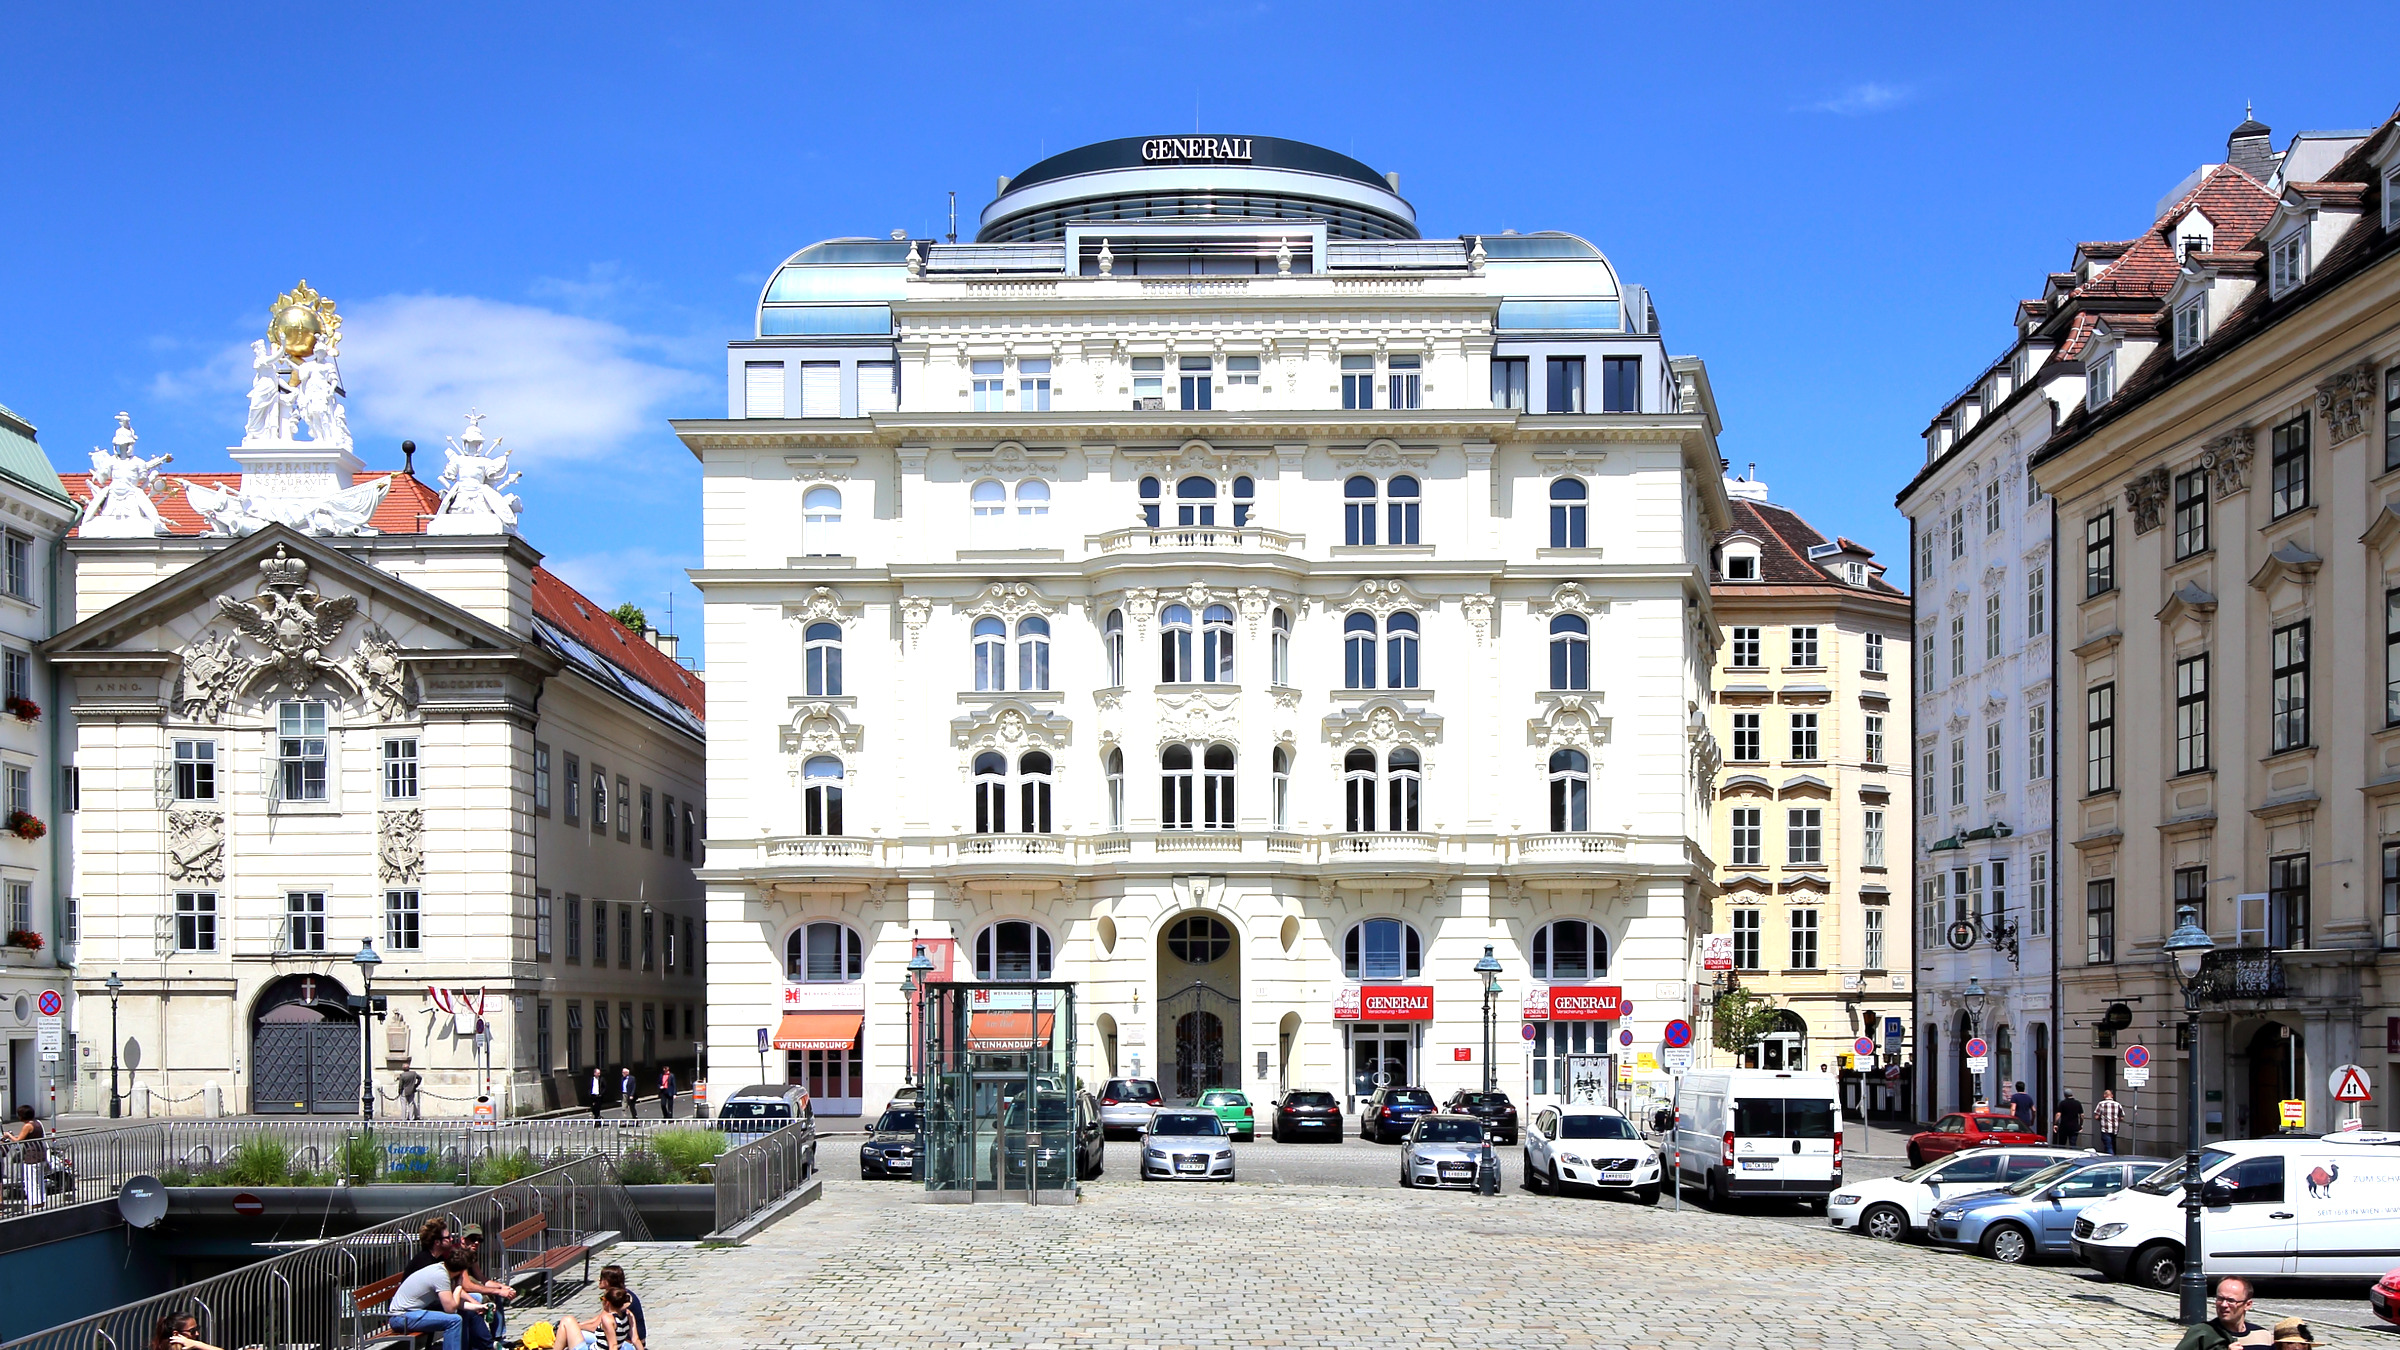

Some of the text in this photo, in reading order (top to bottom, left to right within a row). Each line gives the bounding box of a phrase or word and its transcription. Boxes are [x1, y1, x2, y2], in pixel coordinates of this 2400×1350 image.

[1142, 138, 1252, 160] GENERALI
[1366, 996, 1428, 1009] GENERALI
[1555, 997, 1617, 1009] GENERALI
[779, 1041, 848, 1049] WEINHANDLUNG
